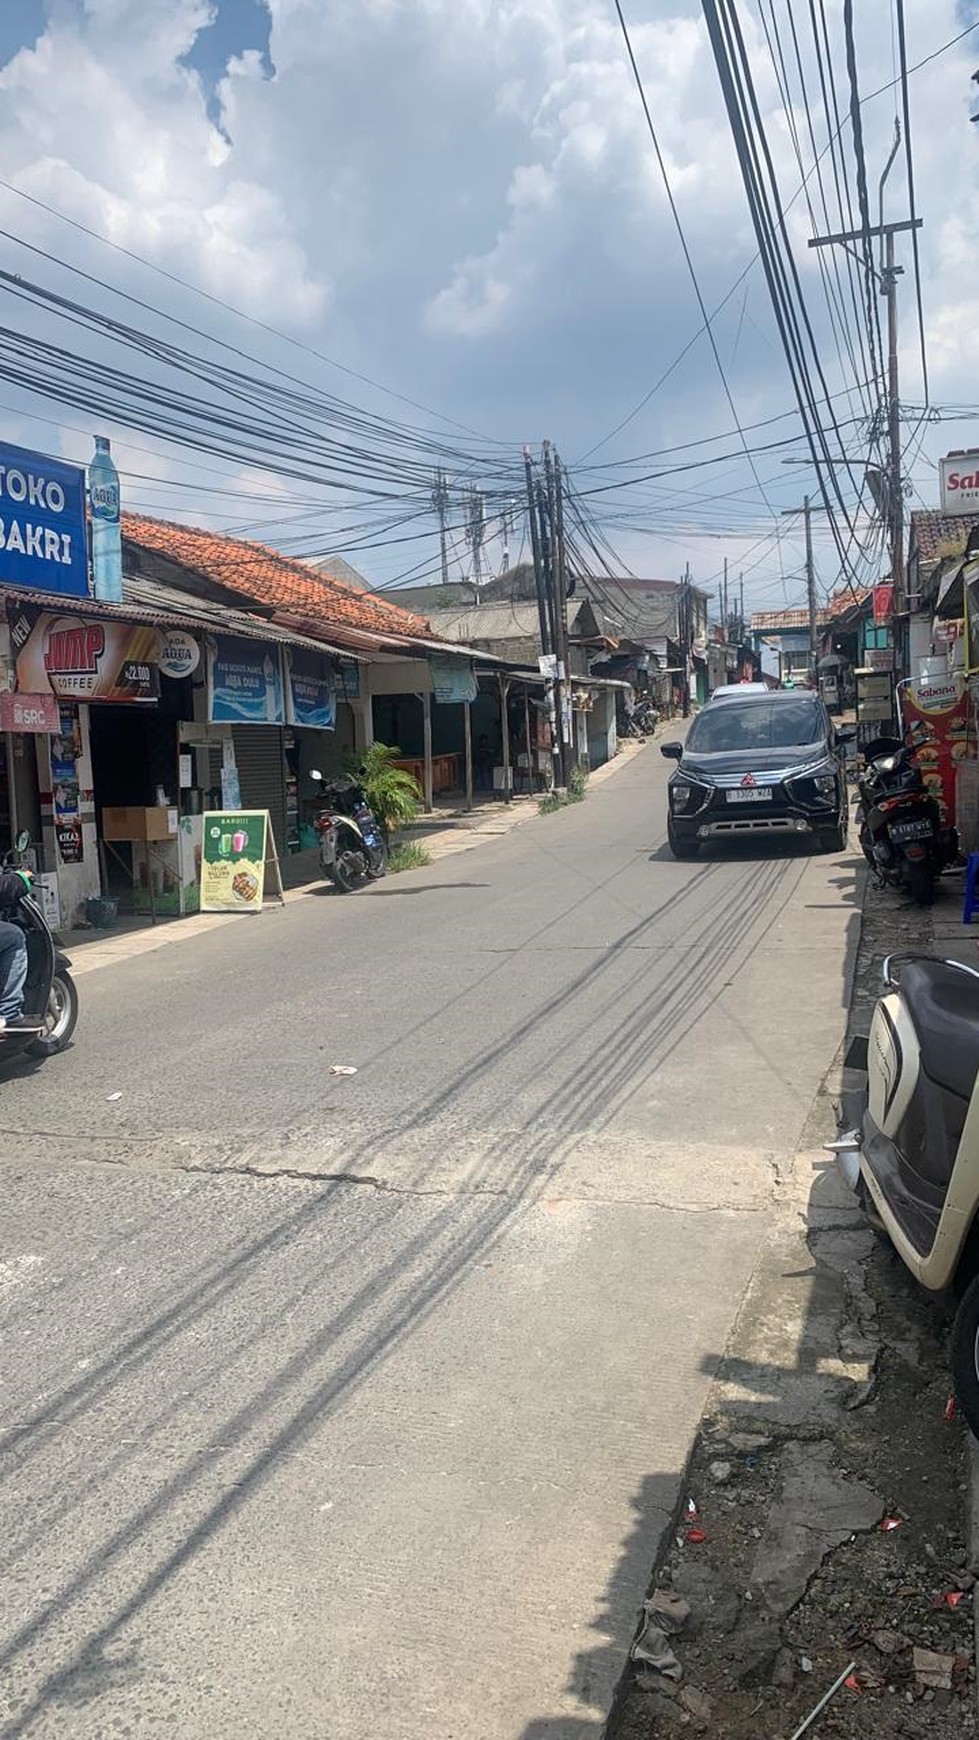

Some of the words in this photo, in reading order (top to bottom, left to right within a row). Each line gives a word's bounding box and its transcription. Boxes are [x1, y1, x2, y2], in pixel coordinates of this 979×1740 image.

[11, 615, 32, 647] NEW
[162, 647, 192, 660] AQUA
[58, 677, 94, 689] COFFEE
[917, 684, 956, 698] Sabana
[24, 708, 46, 724] SRC
